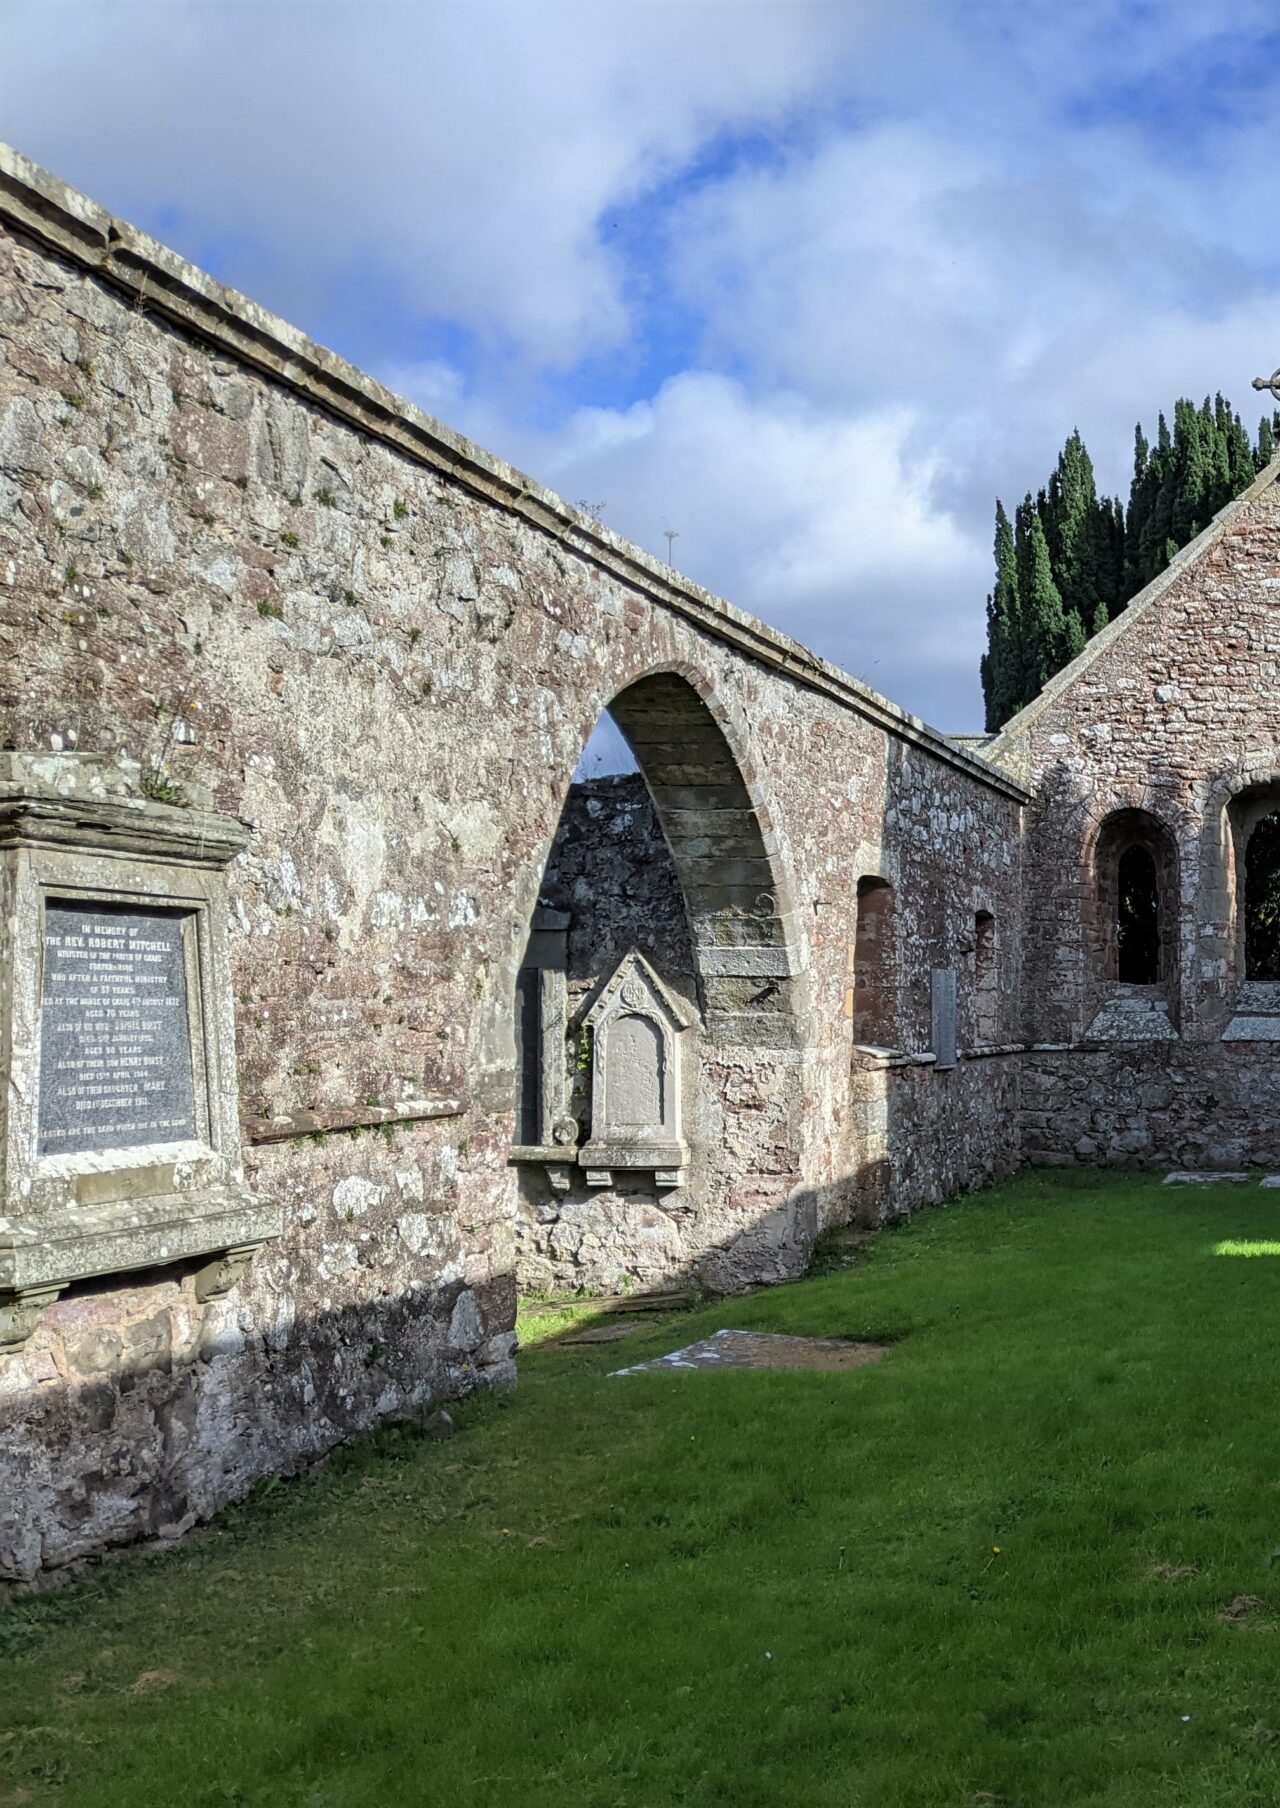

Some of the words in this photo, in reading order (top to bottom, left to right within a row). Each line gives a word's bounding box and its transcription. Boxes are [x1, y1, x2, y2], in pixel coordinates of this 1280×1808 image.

[82, 924, 91, 934] IN
[94, 925, 126, 936] MEMORY
[128, 927, 139, 937] OF
[45, 936, 61, 946] THE
[88, 938, 125, 949] ROBERT
[129, 940, 171, 952] MITCHELL
[57, 950, 89, 959] MINISTER
[89, 951, 98, 959] OF
[98, 952, 111, 960] THE
[112, 952, 134, 961] PARISH
[135, 953, 143, 961] OF
[51, 973, 66, 981] WHO
[68, 974, 91, 982] AFTER
[92, 974, 98, 982] A
[99, 975, 133, 983] FAITHFUL
[134, 976, 168, 984] MINISTRY
[89, 986, 98, 994] OF
[54, 997, 63, 1005] AT
[65, 997, 79, 1005] THE
[102, 997, 111, 1005] OF
[119, 1046, 142, 1054] YEARS
[58, 1060, 75, 1069] ALSO
[76, 1060, 84, 1068] OF
[86, 1060, 104, 1068] THEIR
[106, 1059, 119, 1067] SON
[120, 1057, 142, 1067] HENRY
[79, 1072, 95, 1081] DIED
[113, 1071, 131, 1079] APRIL
[57, 1087, 76, 1096] ALSO
[78, 1087, 85, 1095] OF
[86, 1086, 103, 1095] THEIR
[103, 1084, 138, 1094] DAUGHTER
[75, 1101, 92, 1110] DIED
[39, 1129, 67, 1138] LESSED
[68, 1127, 81, 1136] ARE
[83, 1126, 96, 1135] THE
[98, 1125, 115, 1134] DEAD
[159, 1120, 171, 1128] THE
